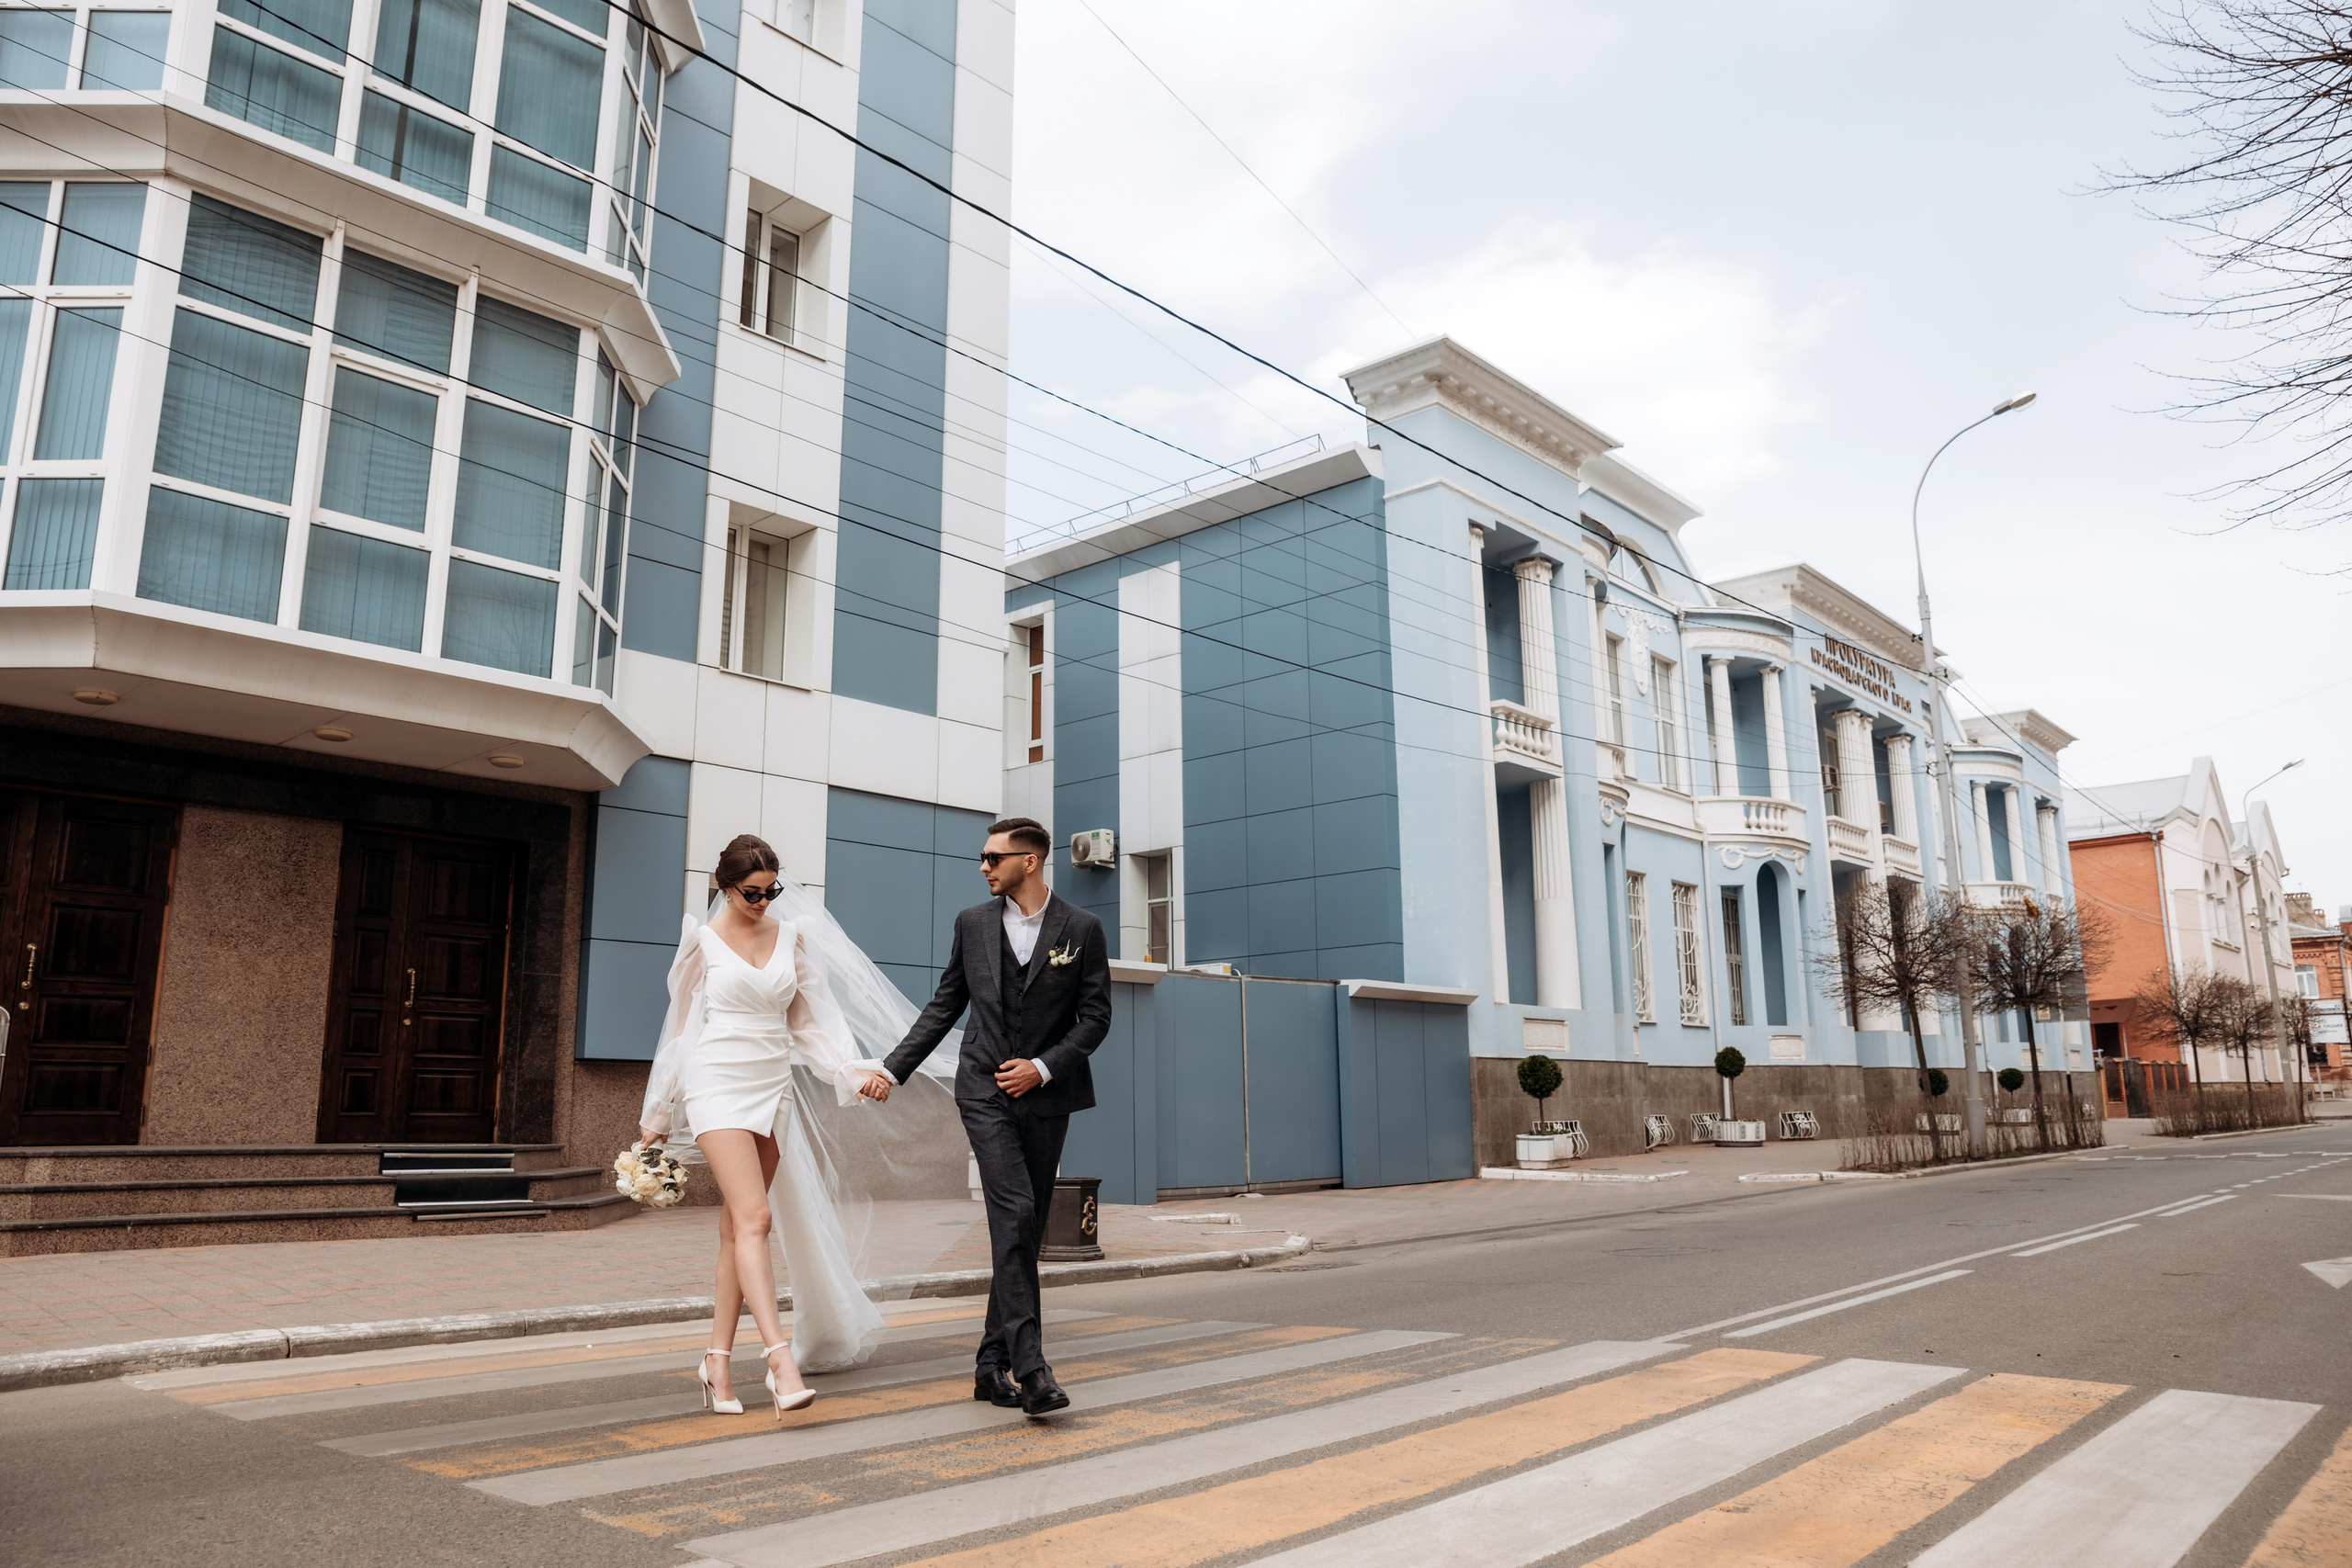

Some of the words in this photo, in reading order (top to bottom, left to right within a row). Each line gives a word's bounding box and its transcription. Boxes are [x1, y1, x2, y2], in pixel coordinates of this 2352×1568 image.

[1810, 647, 1889, 701] КРАСНОДАРСКОГО
[1891, 691, 1912, 713] КРАЯ
[1825, 633, 1896, 689] ПРОКУРАТУРА
